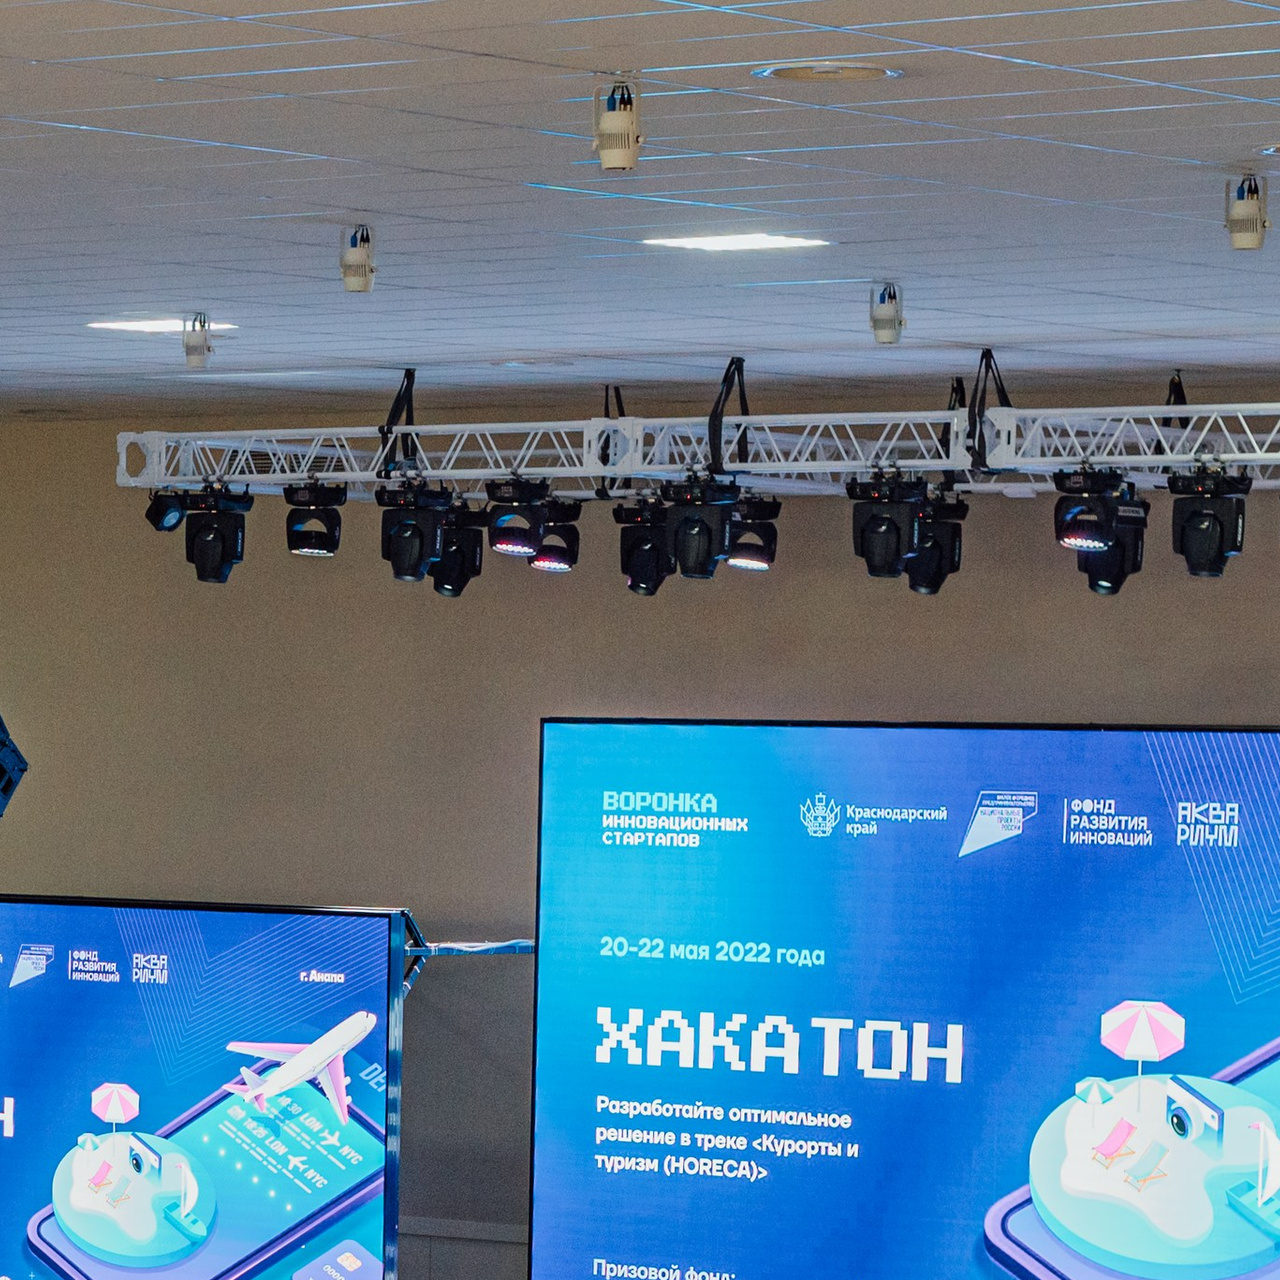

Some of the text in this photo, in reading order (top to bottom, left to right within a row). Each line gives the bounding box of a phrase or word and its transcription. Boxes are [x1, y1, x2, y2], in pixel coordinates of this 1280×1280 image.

[603, 791, 717, 813] ВОРОНКА
[1071, 799, 1115, 815] ФОНД
[846, 804, 947, 822] Краснодарский
[1178, 802, 1239, 824] АКВА
[602, 815, 748, 831] ИННОВАЦИОННЫХ
[846, 822, 878, 836] край
[1071, 815, 1148, 830] РАЗВИТИЯ
[602, 832, 700, 847] СТАРТАПОВ
[1070, 830, 1153, 846] ИННОВАЦИЙ
[72, 950, 98, 961] ФОНД
[600, 936, 825, 967] 20-22 мая 2022 года
[72, 961, 117, 972] РАЗВИТИЯ
[72, 971, 120, 983] ИННОВАЦИЙ
[300, 970, 345, 983] г. Анапа
[596, 1095, 852, 1129] Разработайте оптимальное
[299, 1112, 321, 1133] LON
[339, 1145, 364, 1165] NYC
[595, 1126, 859, 1158] решение в треке <Курорты и
[264, 1135, 289, 1156] LON
[303, 1168, 328, 1189] NYC
[595, 1155, 768, 1182] туризм (HORECA)>
